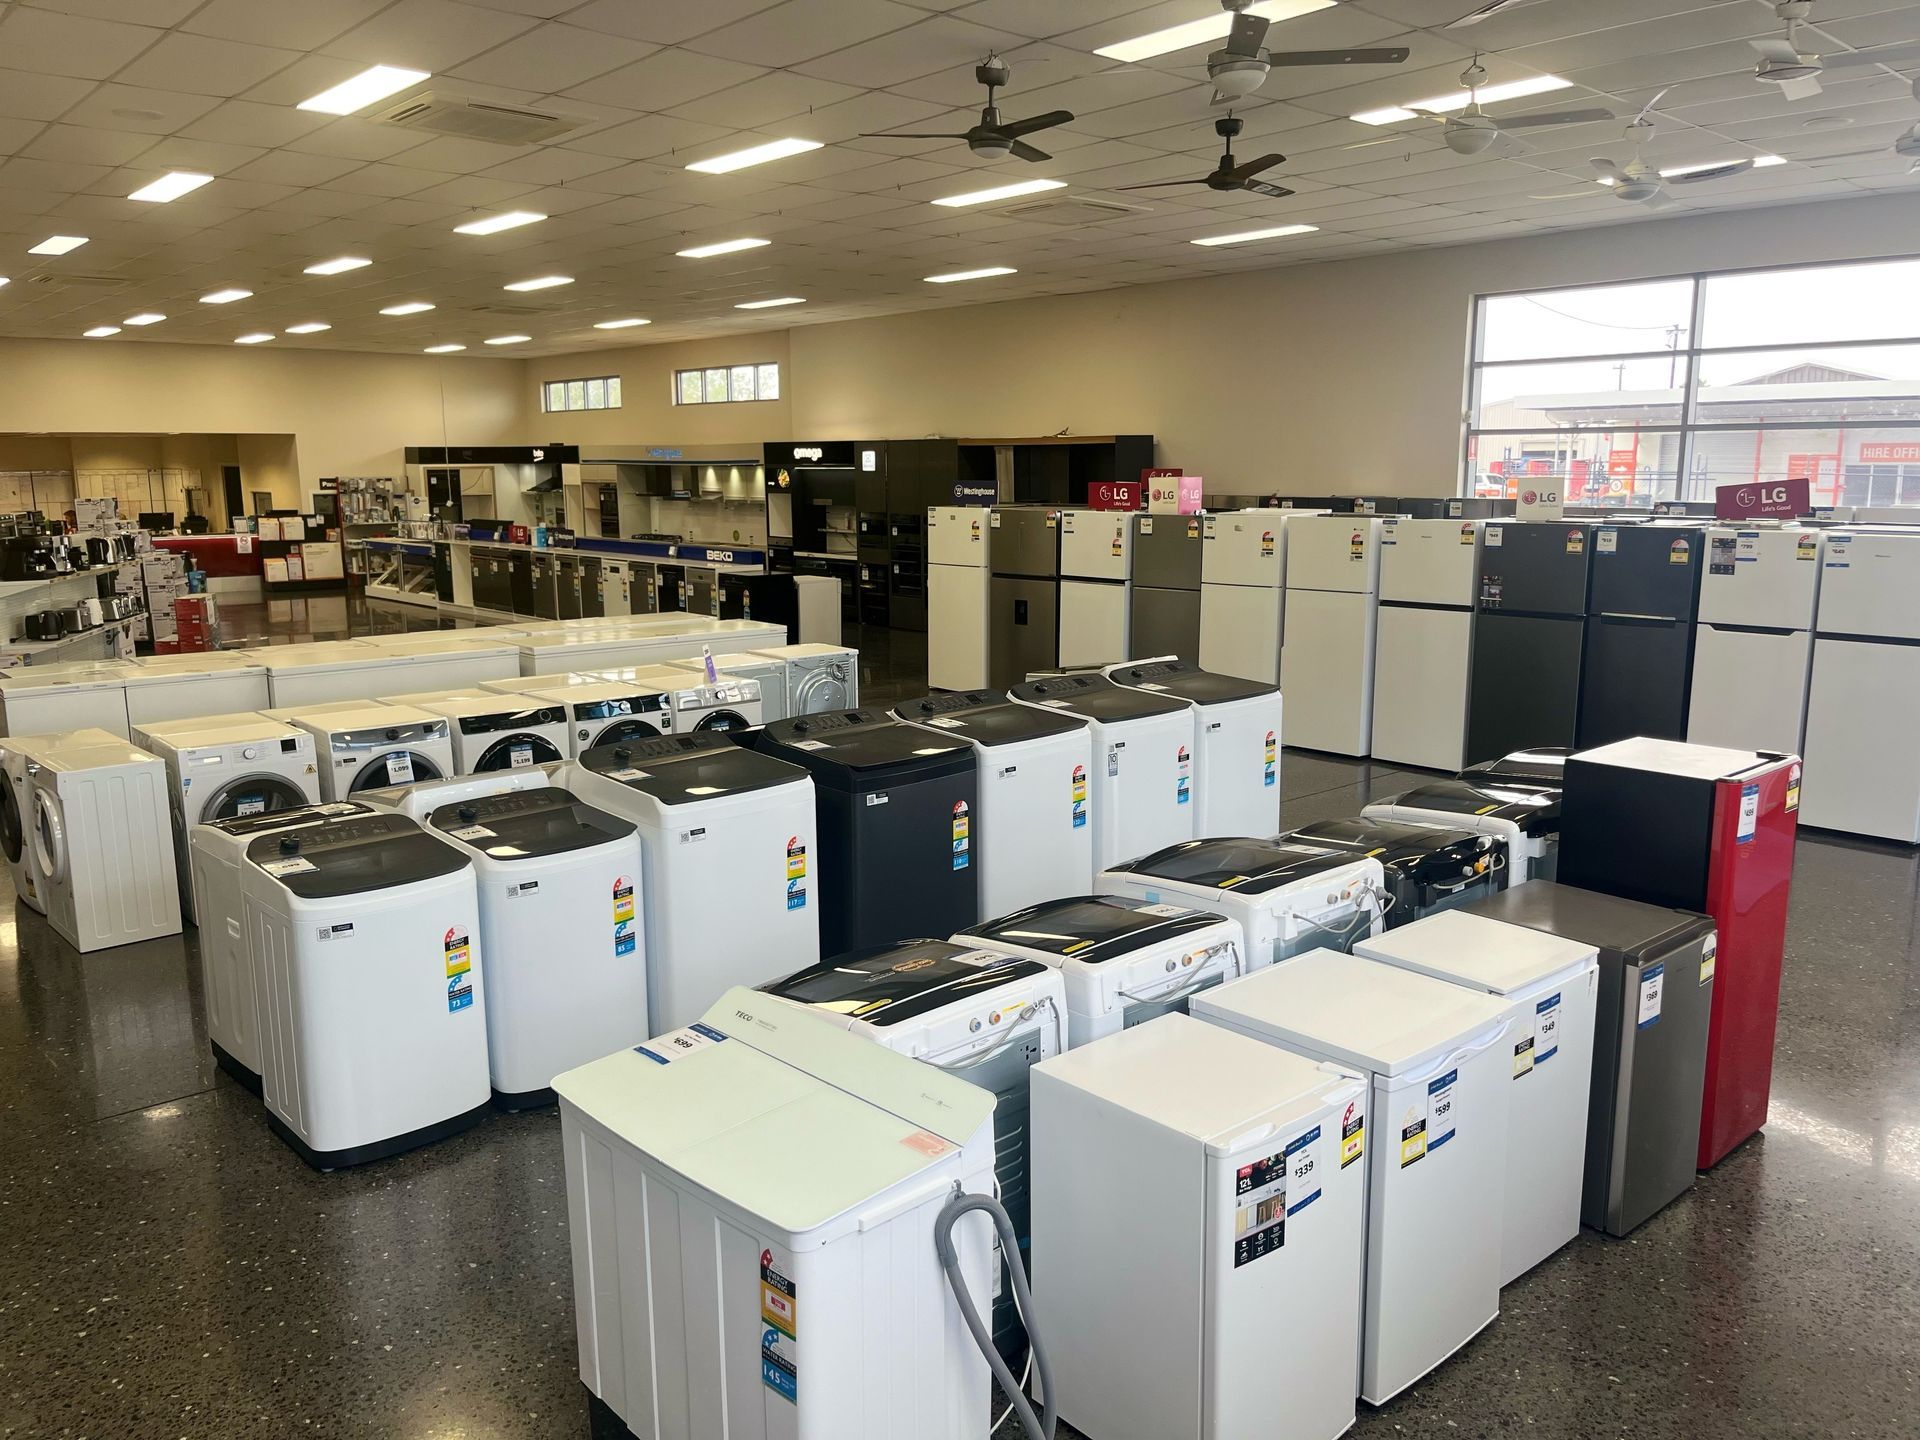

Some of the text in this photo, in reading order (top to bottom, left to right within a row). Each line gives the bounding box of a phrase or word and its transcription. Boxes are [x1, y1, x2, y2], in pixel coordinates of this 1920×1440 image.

[1863, 447, 1890, 458] HIRE
[964, 488, 995, 496] Westinghouse
[1114, 488, 1128, 500] LG
[1162, 490, 1174, 500] LG
[1190, 490, 1200, 499] LG
[1540, 492, 1556, 502] LG
[1762, 487, 1786, 504] LG
[706, 550, 733, 562] BEKO
[735, 1010, 754, 1022] TECO
[1435, 1102, 1450, 1116] $599
[1294, 1160, 1314, 1178] $339
[767, 1269, 788, 1286] ENERGY
[768, 1276, 788, 1293] RATING
[762, 1346, 796, 1372] WATER RATING
